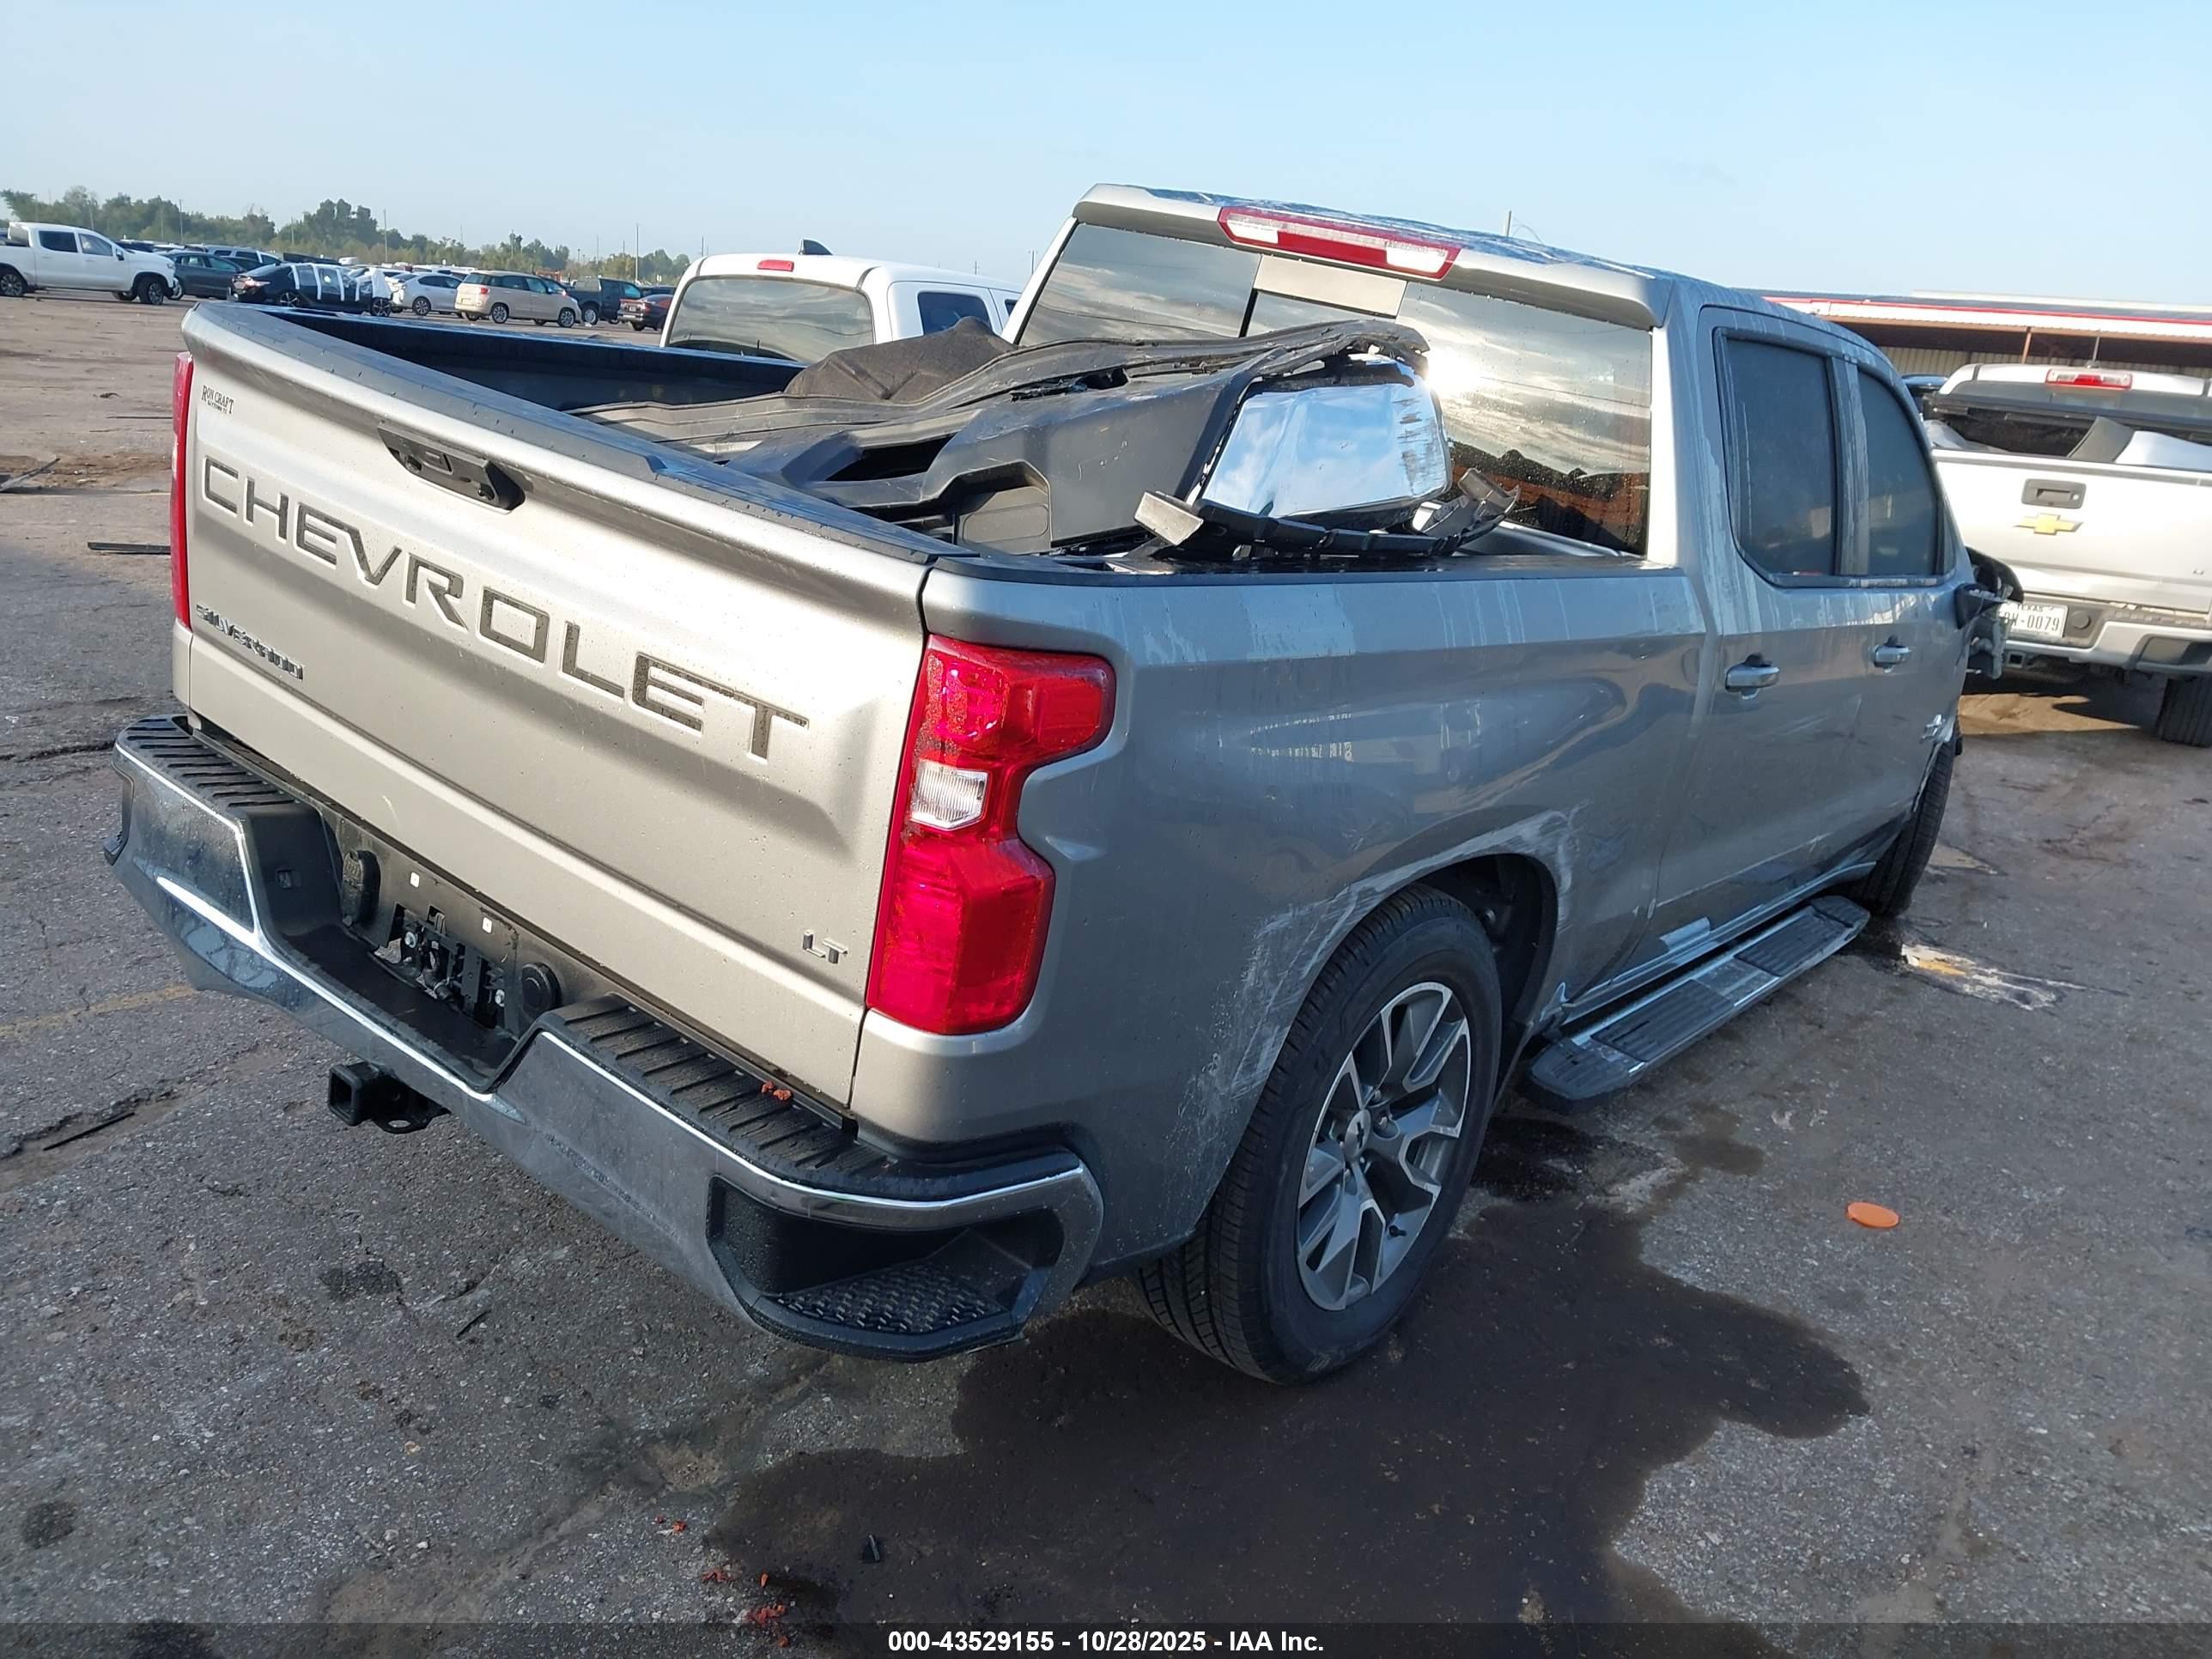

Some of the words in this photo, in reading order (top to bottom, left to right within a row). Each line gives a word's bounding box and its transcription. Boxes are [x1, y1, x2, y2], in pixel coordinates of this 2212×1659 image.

[201, 384, 215, 402] RON
[215, 391, 234, 414] CRAFT
[204, 455, 810, 762] CHEVROLET
[2016, 603, 2045, 612] TEXAS
[195, 604, 304, 681] SILVERADO
[801, 929, 848, 965] LT
